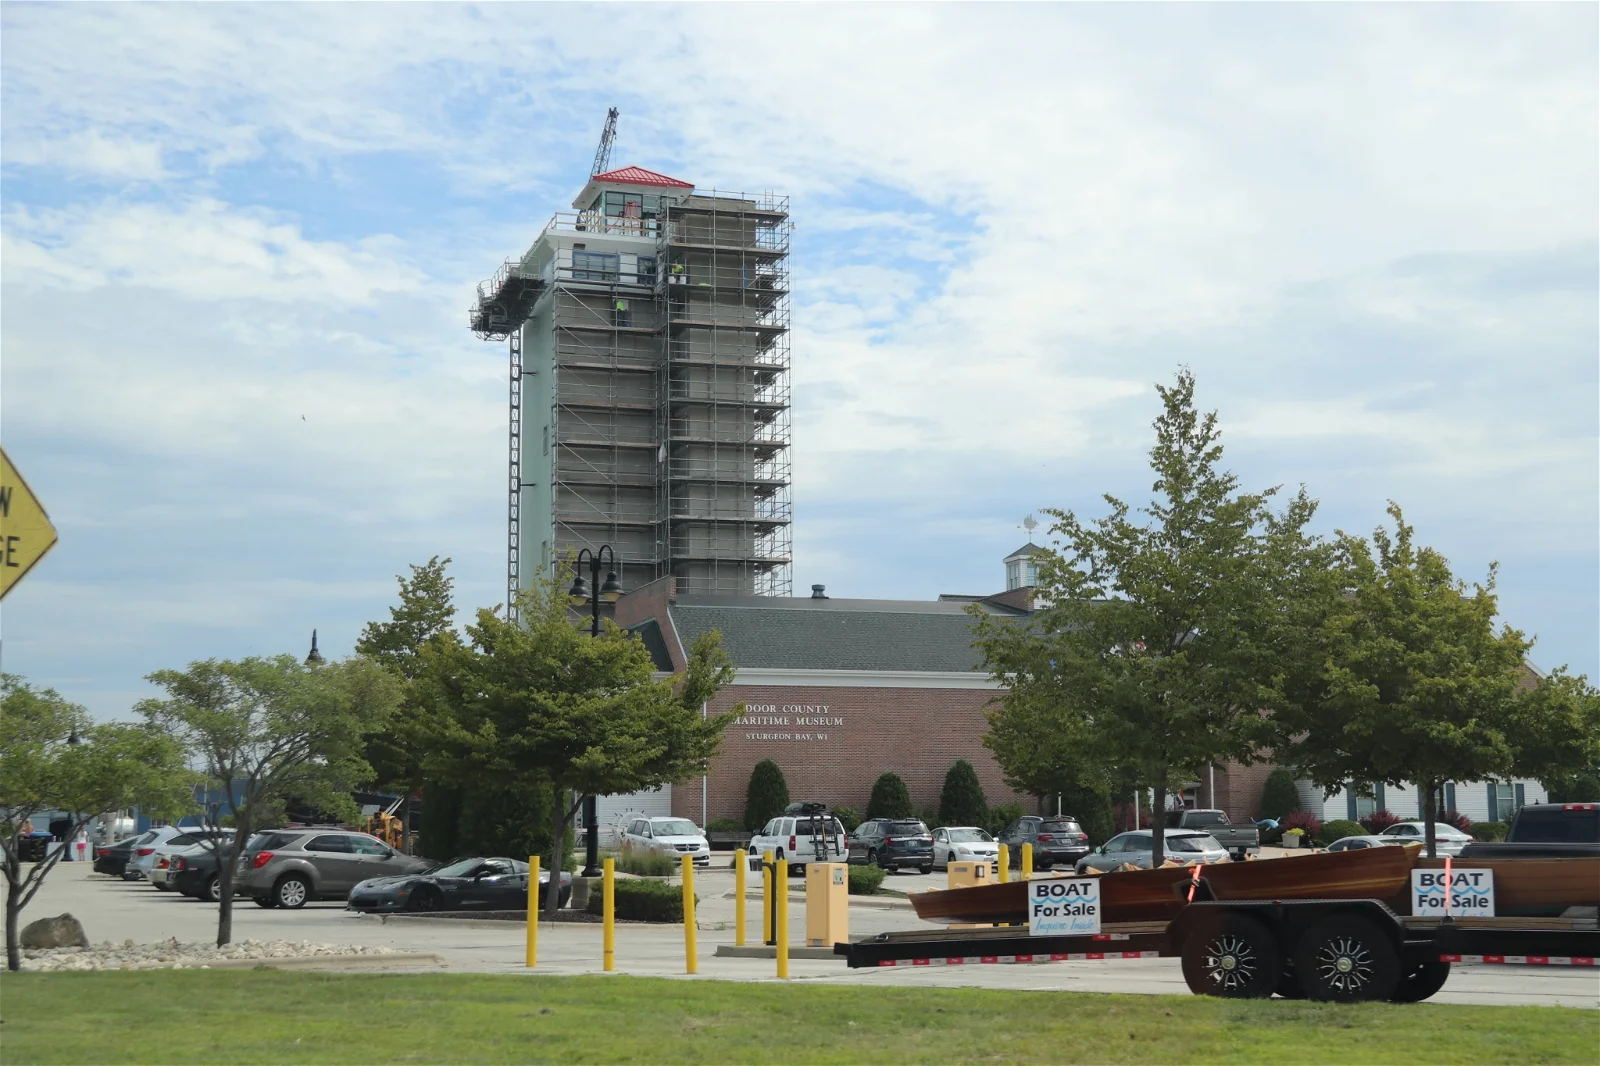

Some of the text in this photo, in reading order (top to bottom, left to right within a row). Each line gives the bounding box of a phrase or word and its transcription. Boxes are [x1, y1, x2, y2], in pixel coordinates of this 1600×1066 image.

[745, 704, 829, 713] DOOR COUNTY
[731, 717, 843, 726] MARITIME MUSEUM
[795, 733, 813, 741] BAY,
[1419, 873, 1484, 887] BOAT
[1036, 883, 1092, 897] BOAT
[1418, 895, 1489, 908] For Sale
[1034, 903, 1096, 917] For Sale
[1036, 918, 1094, 932] Inquire Inside
